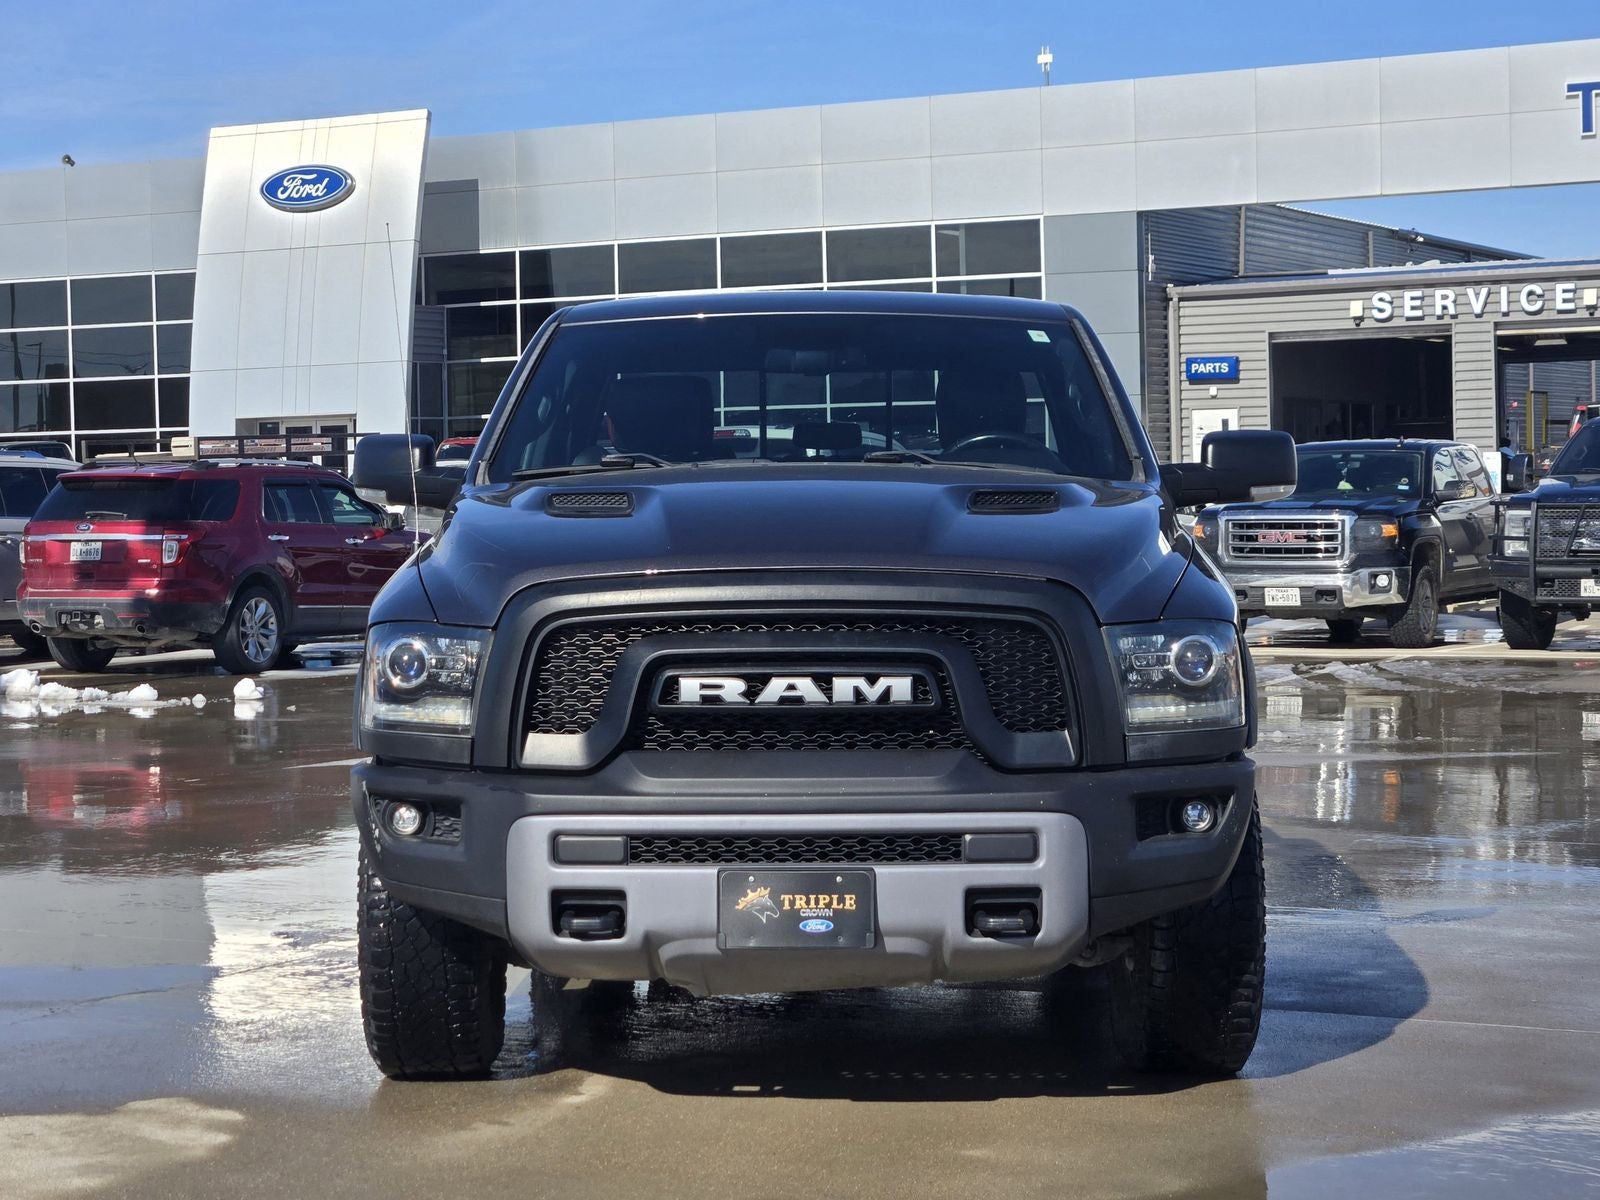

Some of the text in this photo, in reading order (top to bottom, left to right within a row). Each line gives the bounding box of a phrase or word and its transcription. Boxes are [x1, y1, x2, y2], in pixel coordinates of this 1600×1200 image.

[1565, 80, 1600, 137] T
[277, 173, 330, 200] Ford
[1371, 282, 1577, 321] SERVICE
[1191, 362, 1229, 374] PARTS
[1258, 531, 1307, 544] GMC
[678, 676, 913, 704] RAM
[780, 894, 857, 911] TRIPLE
[800, 908, 833, 917] CROWN
[805, 921, 827, 930] Ford
